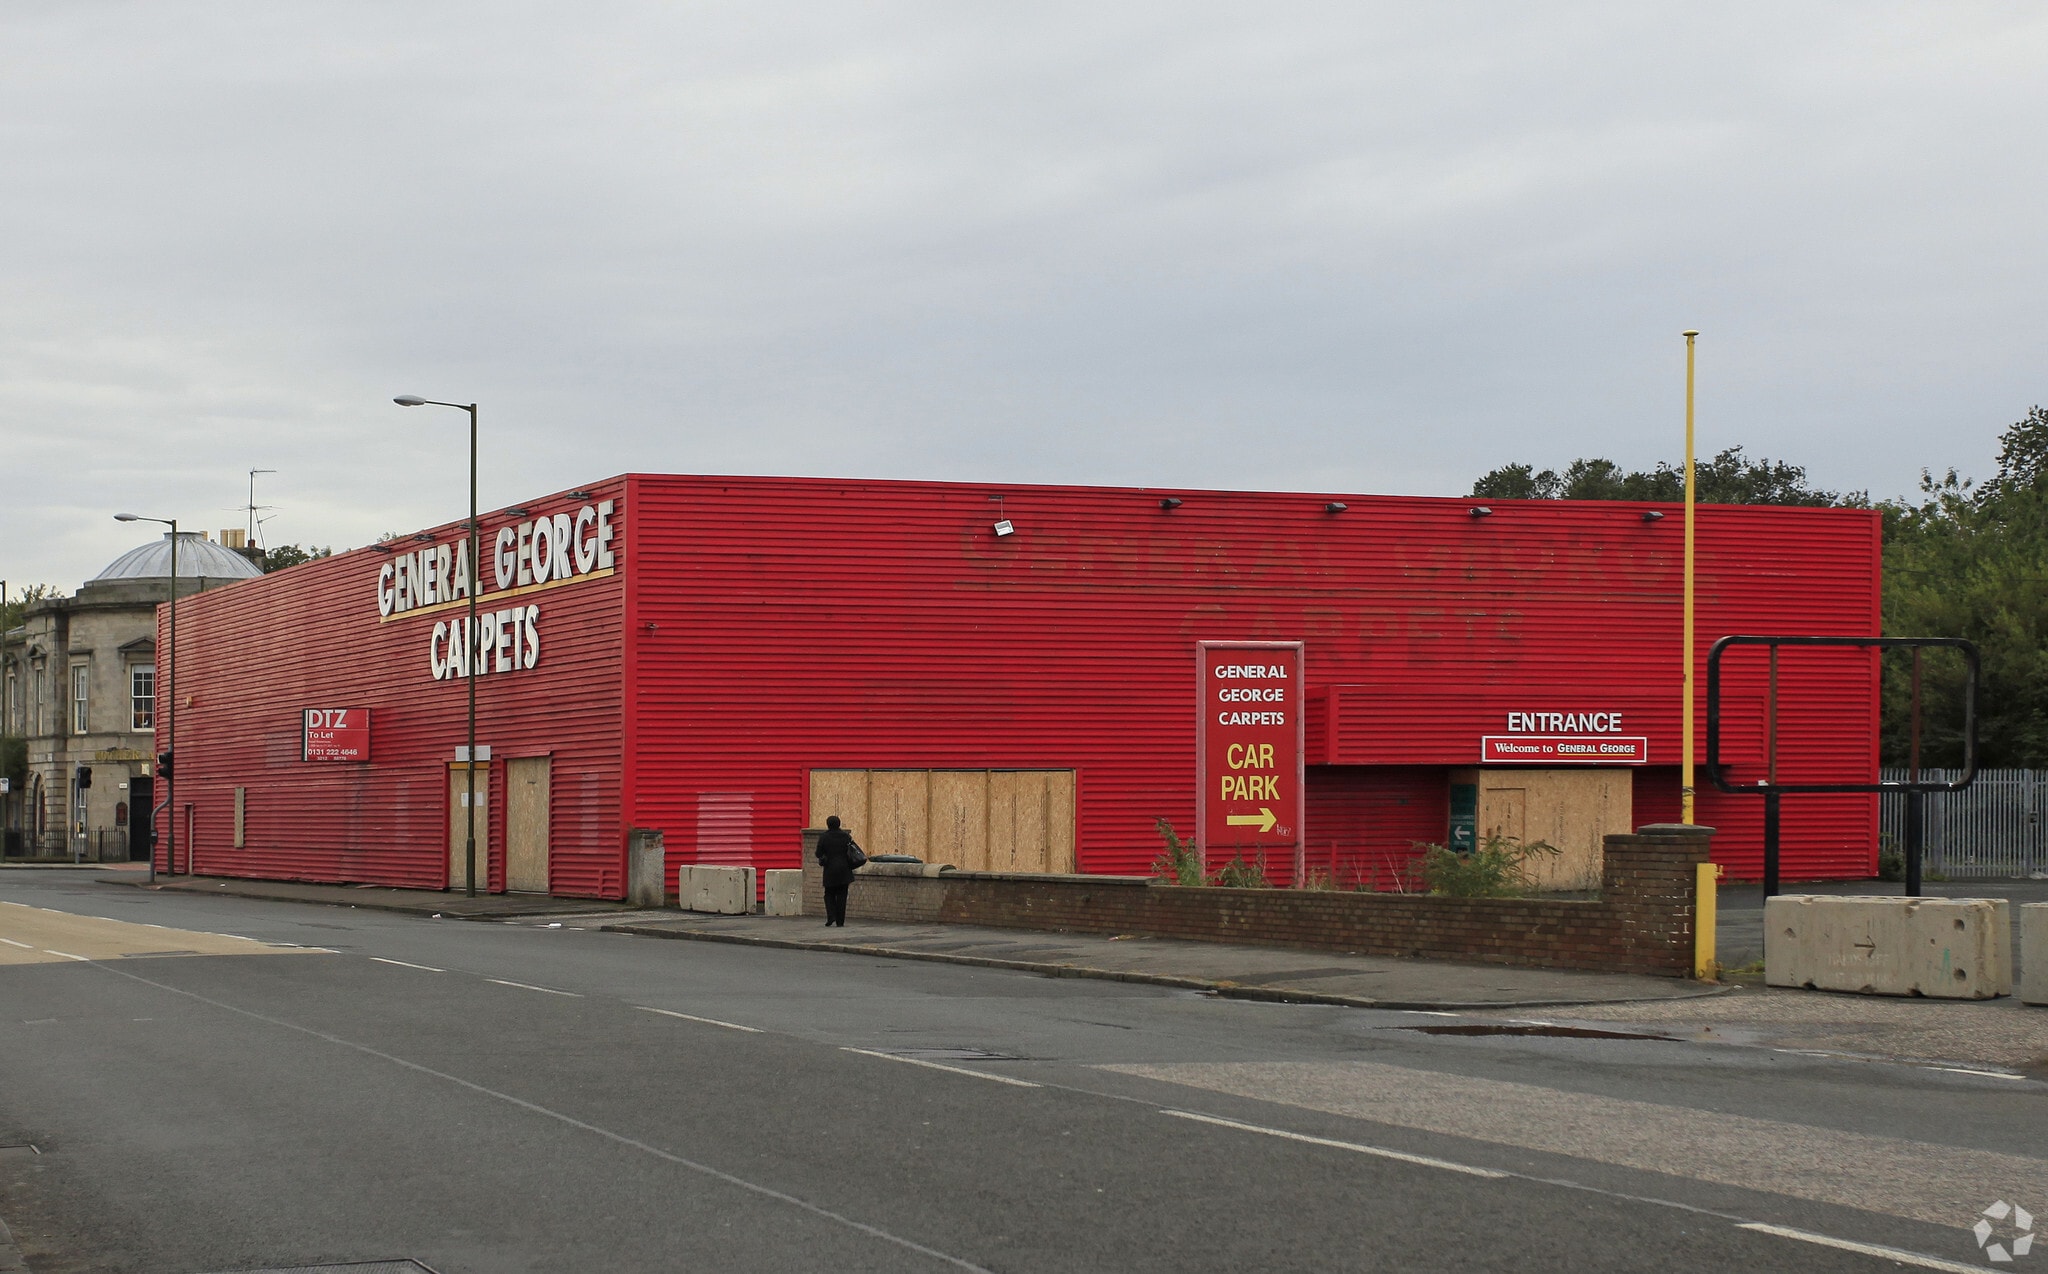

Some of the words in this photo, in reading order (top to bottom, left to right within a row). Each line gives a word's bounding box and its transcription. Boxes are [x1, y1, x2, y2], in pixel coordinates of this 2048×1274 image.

[378, 535, 484, 617] GENERAL
[494, 499, 615, 590] GEORGE
[431, 604, 540, 680] CARPETS
[1214, 665, 1287, 679] GENERAL
[1218, 688, 1284, 702] GEORGE
[308, 709, 347, 728] DTZ
[1218, 711, 1285, 725] CARPETS
[1507, 712, 1623, 732] ENTRANCE
[1227, 743, 1274, 770] CAR
[1494, 742, 1540, 753] Welcome
[1542, 743, 1553, 753] to
[1557, 743, 1597, 753] GENERAL
[1599, 743, 1636, 753] GEORGE
[1221, 775, 1281, 800] PARK
